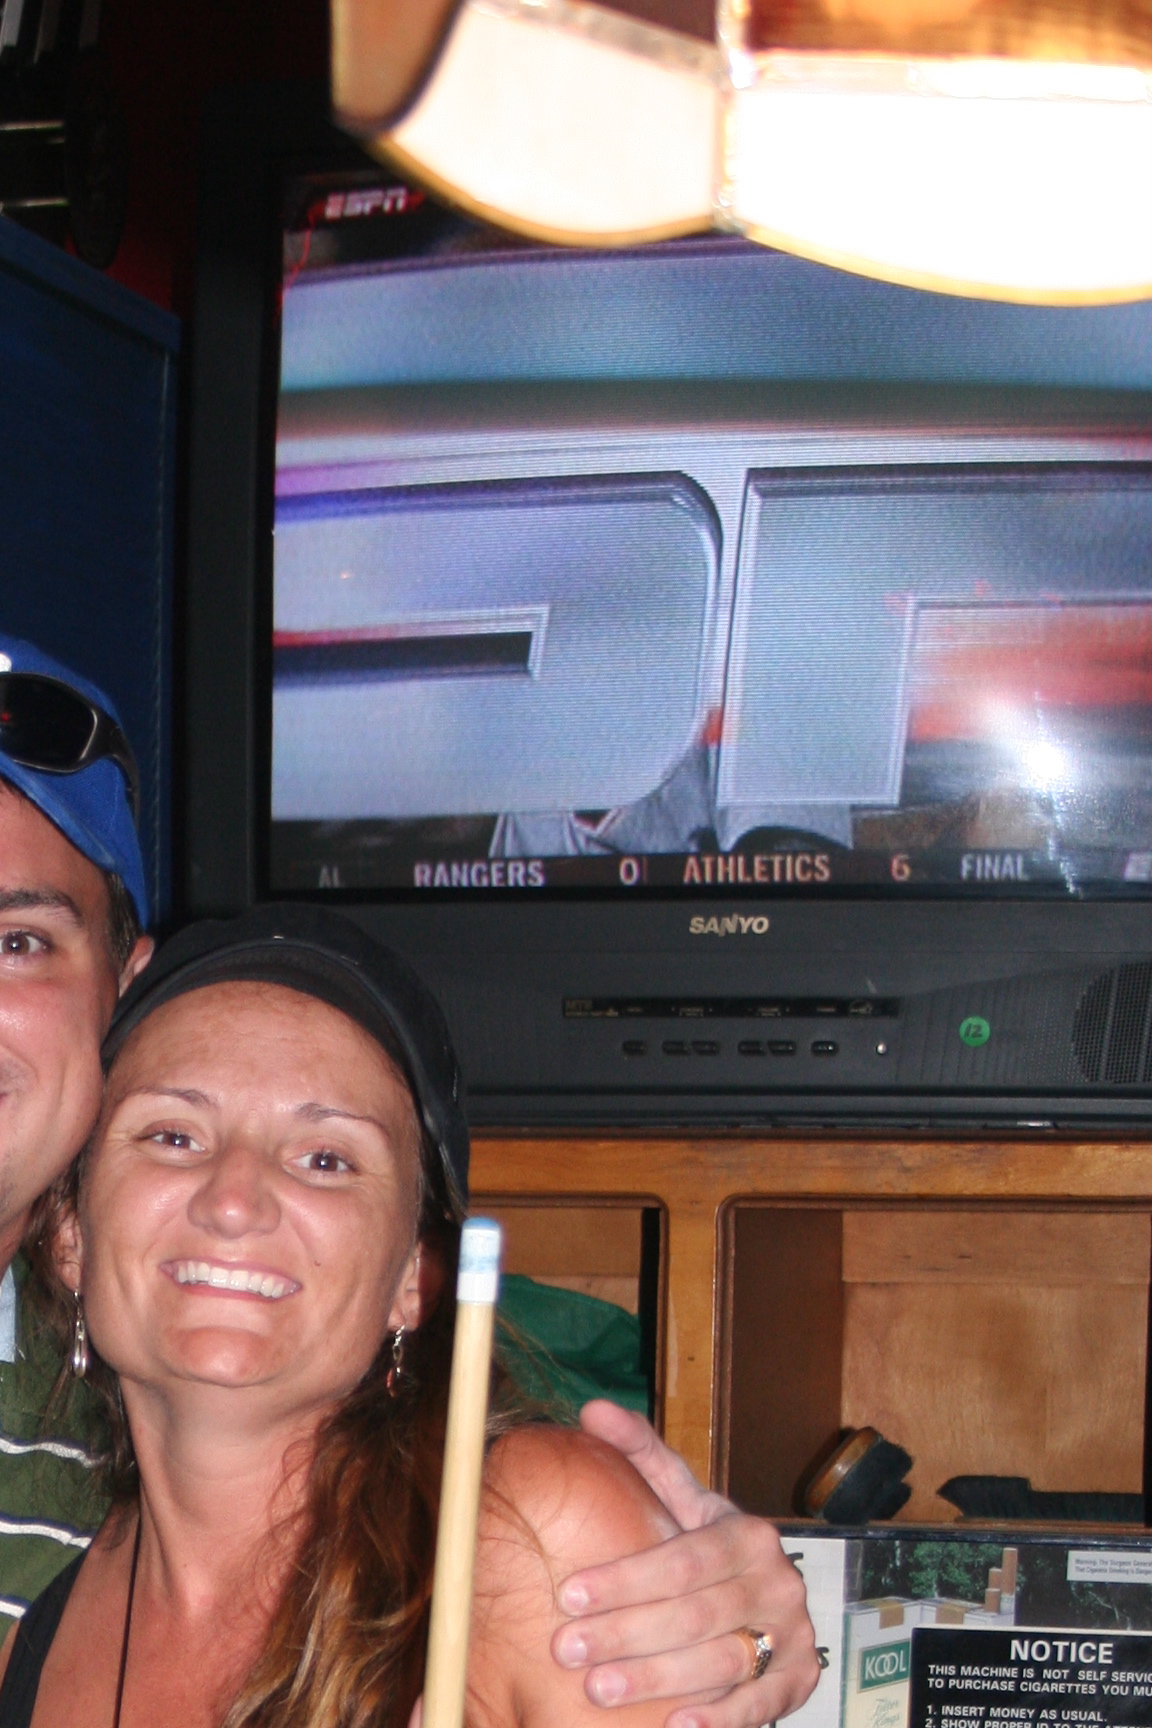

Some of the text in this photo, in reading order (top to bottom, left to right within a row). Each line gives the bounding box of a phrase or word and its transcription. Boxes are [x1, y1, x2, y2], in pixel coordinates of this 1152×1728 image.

[324, 186, 408, 219] ESPN
[413, 859, 545, 888] RANGERS
[683, 854, 831, 884] ATHLETICS
[890, 853, 911, 883] 6
[960, 853, 1030, 882] FINAL
[689, 913, 770, 937] SANYO
[1009, 1639, 1114, 1664] NOTICE
[864, 1649, 907, 1680] KOOL
[928, 1664, 956, 1676] THIS
[960, 1665, 1019, 1678] MACHINE
[1022, 1667, 1035, 1679] IS
[1042, 1668, 1069, 1680] NOT
[1077, 1670, 1107, 1682] SELF
[927, 1678, 944, 1689] TO
[948, 1679, 1015, 1692] PURCHASE
[1019, 1681, 1097, 1695] CIGARETTES
[1101, 1684, 1129, 1697] YOU
[926, 1704, 1108, 1723] 1. INSERT MONEY AS USUAL.
